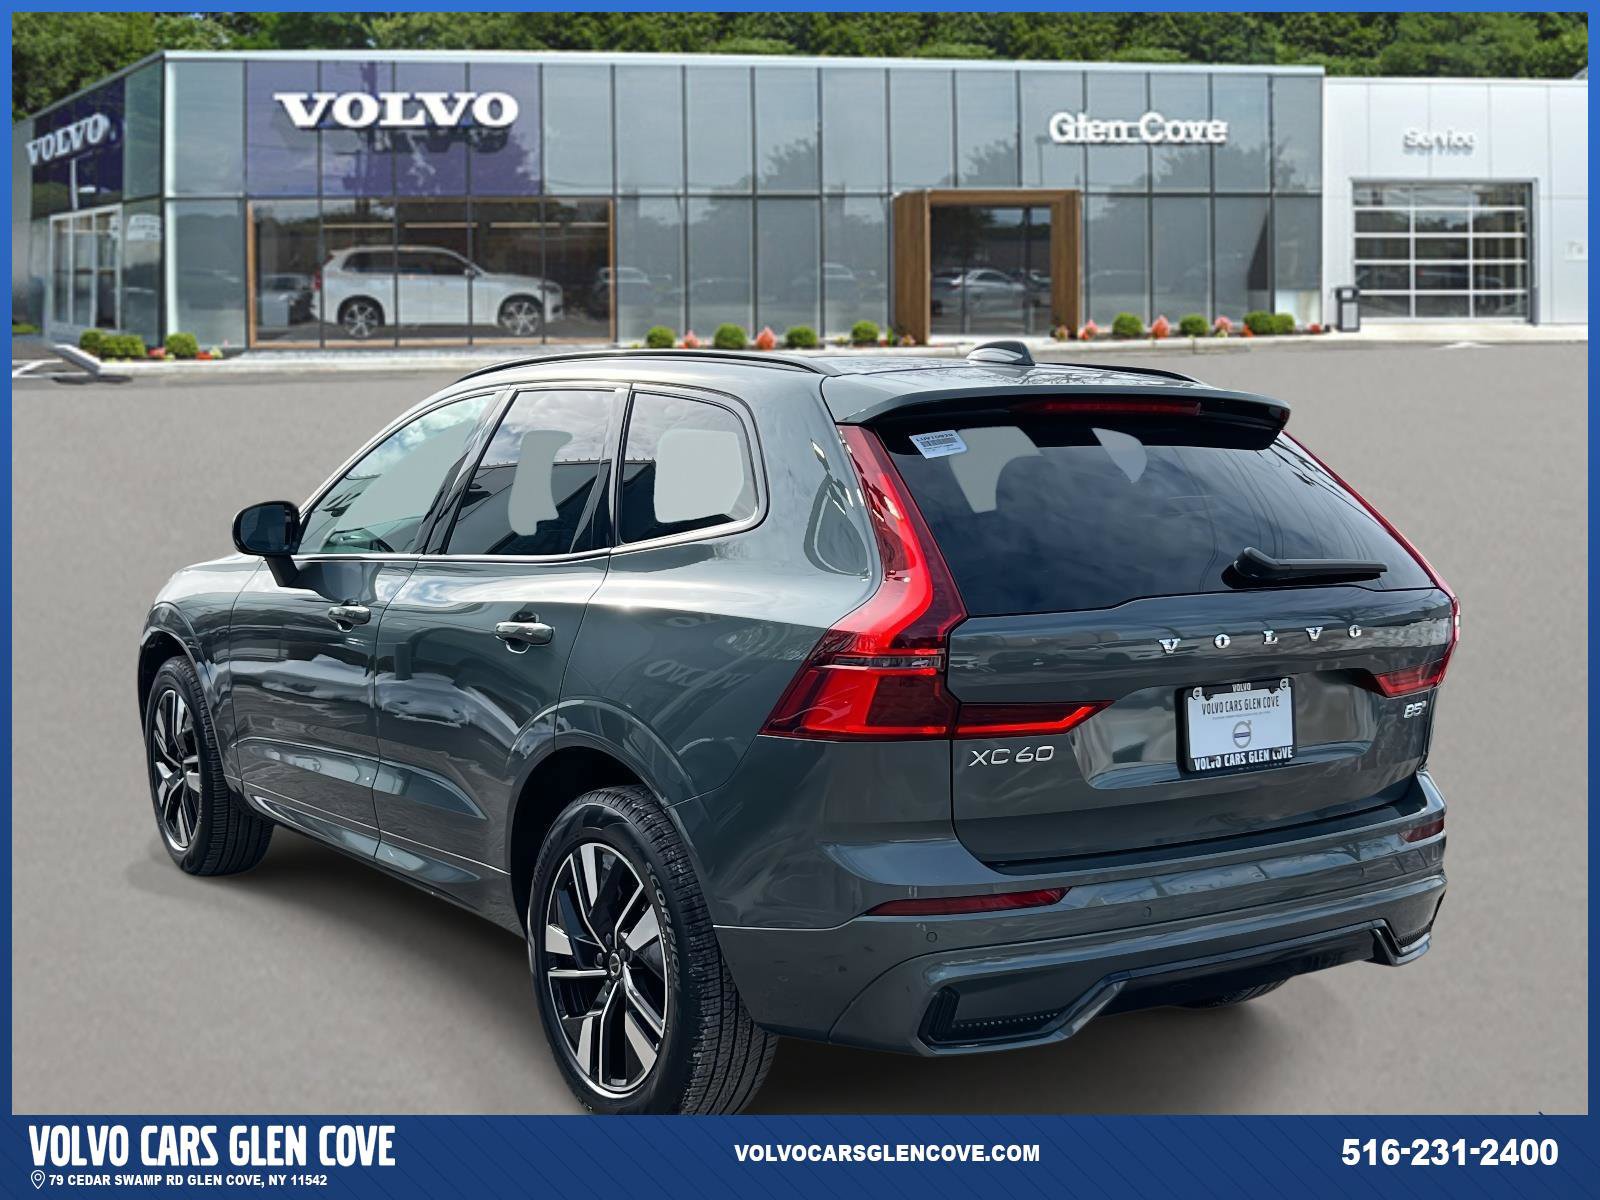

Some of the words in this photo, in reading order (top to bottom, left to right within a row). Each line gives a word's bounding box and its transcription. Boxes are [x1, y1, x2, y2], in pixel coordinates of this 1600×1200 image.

[274, 93, 518, 127] VOLVO
[26, 113, 109, 165] VOLVO
[1050, 112, 1128, 143] Glen
[1139, 112, 1228, 143] Cove
[1403, 128, 1475, 153] Service
[1159, 624, 1363, 654] VOLVO
[1232, 683, 1251, 692] VOLVO
[1202, 701, 1224, 715] VOLVO
[1225, 699, 1243, 712] CARS
[1244, 697, 1261, 710] GLEN
[1263, 696, 1280, 708] COVE
[1224, 753, 1246, 767] CARS
[1248, 750, 1270, 763] GLEN
[645, 861, 682, 992] SCORPION
